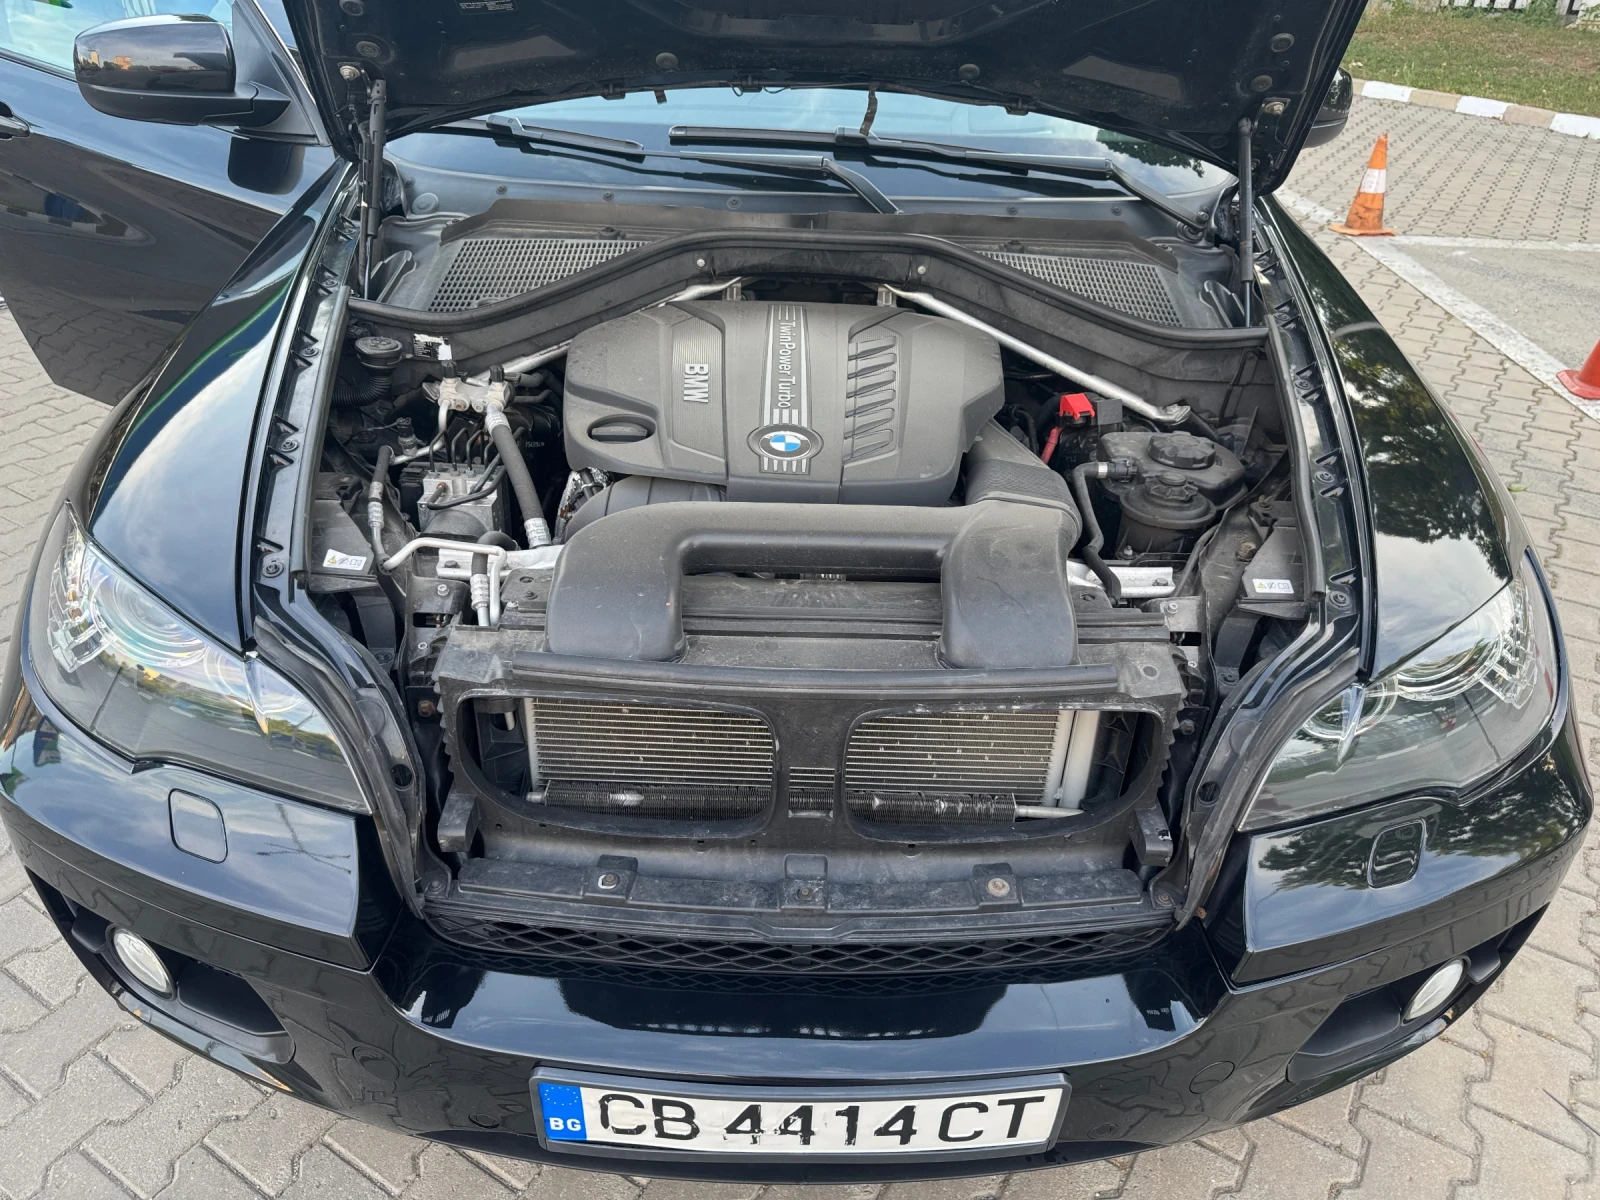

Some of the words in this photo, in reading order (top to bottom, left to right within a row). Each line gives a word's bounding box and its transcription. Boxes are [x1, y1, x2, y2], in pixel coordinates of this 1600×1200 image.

[779, 321, 796, 376] TwinPower
[683, 363, 709, 403] BMW
[778, 376, 796, 408] Turbo
[549, 1117, 582, 1132] BG
[599, 1093, 700, 1141] CB
[724, 1104, 918, 1146] 4414
[938, 1096, 1046, 1143] CT
